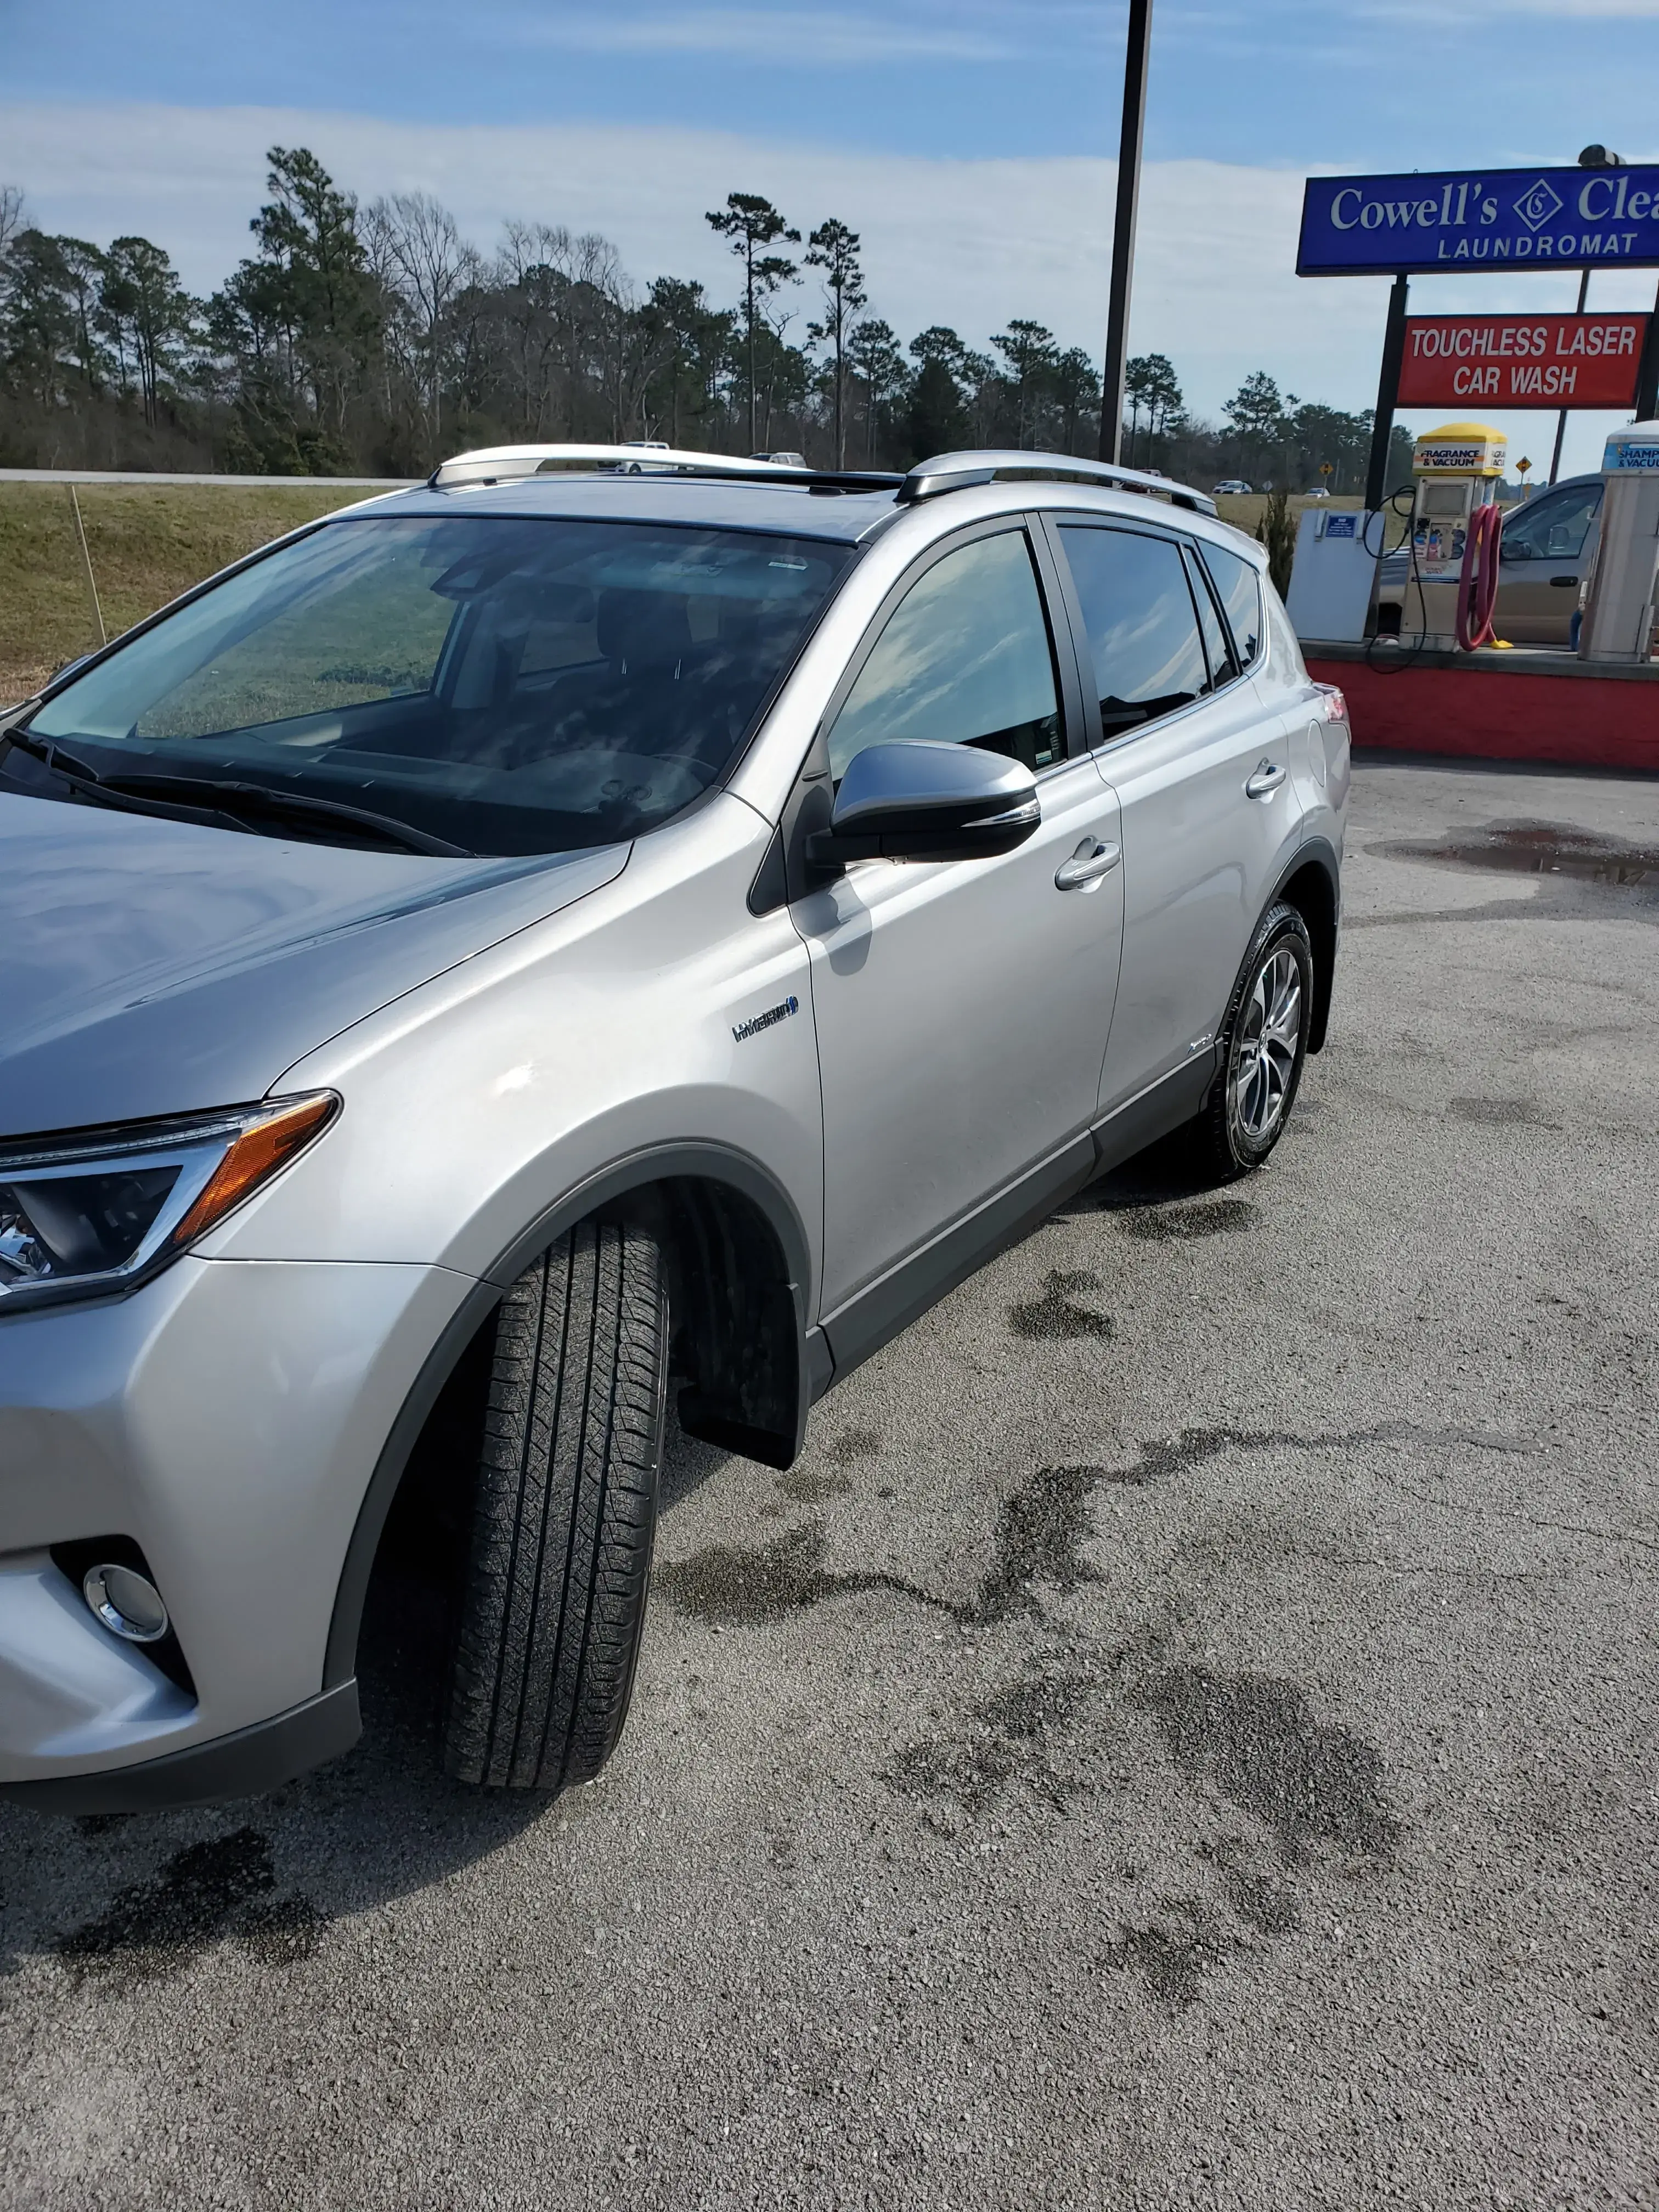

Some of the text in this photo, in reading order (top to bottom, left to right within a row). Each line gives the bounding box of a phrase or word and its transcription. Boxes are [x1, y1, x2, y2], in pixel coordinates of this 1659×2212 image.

[1330, 182, 1498, 229] Cowell's
[1438, 233, 1638, 258] LAUNDROMAT
[1412, 326, 1636, 357] TOUCHLESS LASER
[1453, 366, 1577, 394] CAR WASH
[1423, 458, 1475, 466] & VACUUM
[1618, 459, 1624, 467] &
[732, 1003, 791, 1043] HYBRID
